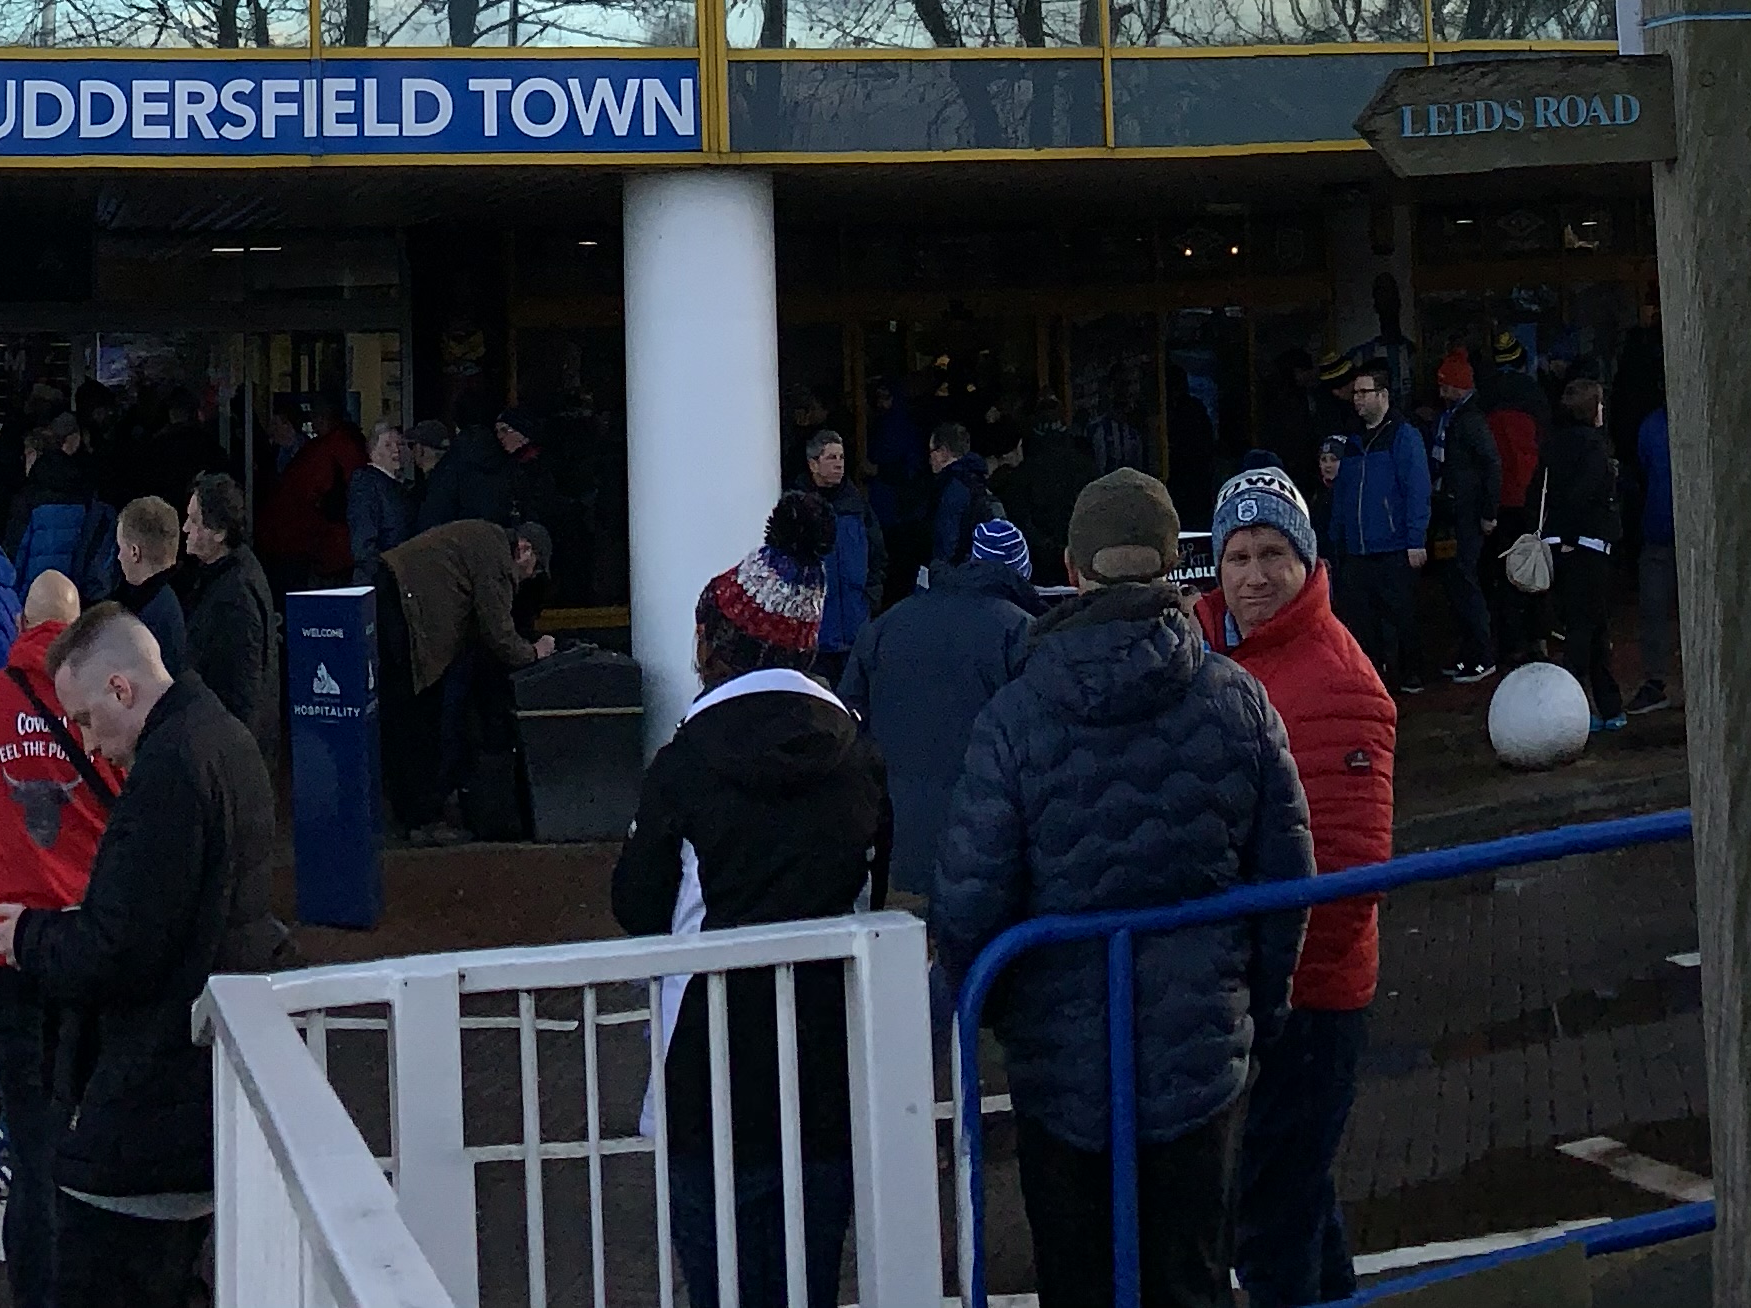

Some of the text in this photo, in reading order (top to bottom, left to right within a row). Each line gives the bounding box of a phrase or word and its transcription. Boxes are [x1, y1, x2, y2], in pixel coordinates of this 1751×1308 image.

[467, 75, 695, 138] TOWN
[1400, 92, 1641, 138] LEEDS ROAD
[301, 627, 344, 638] WELCOME
[293, 704, 361, 717] HOSPITALITY
[22, 740, 47, 757] THE
